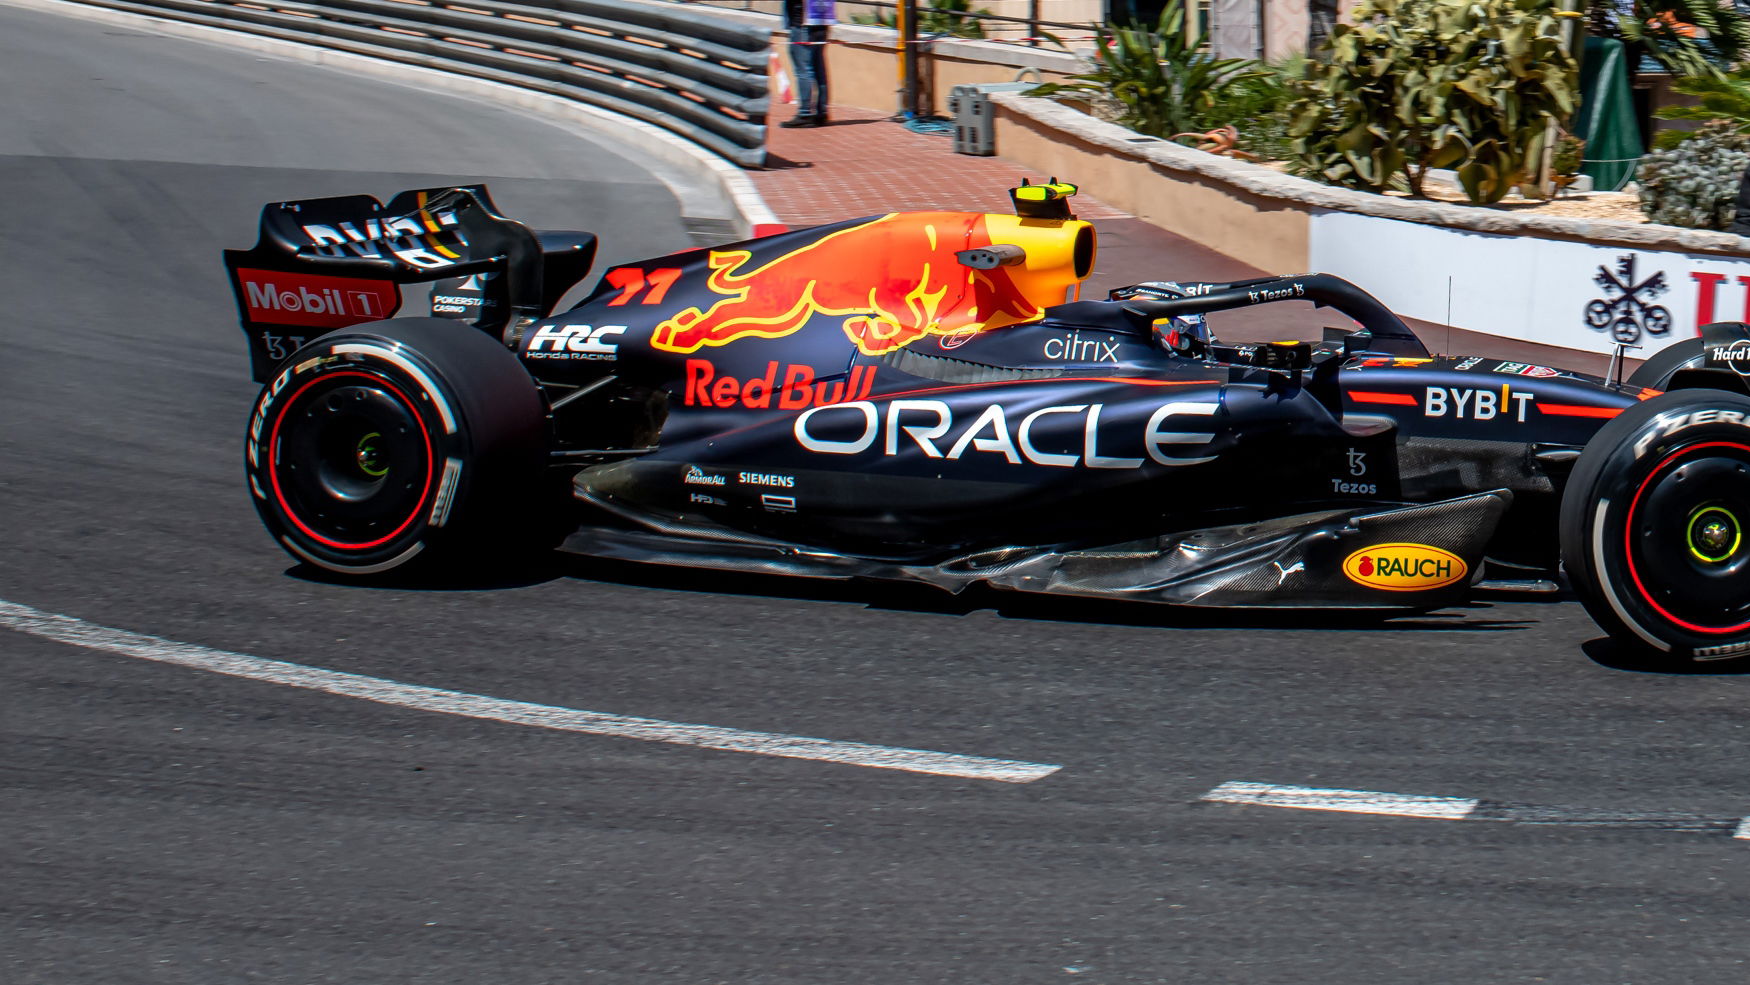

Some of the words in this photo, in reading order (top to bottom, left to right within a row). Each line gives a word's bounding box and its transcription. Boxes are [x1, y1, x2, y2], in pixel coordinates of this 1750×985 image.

[246, 281, 346, 315] Mobil
[1260, 285, 1294, 301] Tezos
[433, 303, 466, 314] CASINO
[527, 324, 628, 353] HRC
[1044, 332, 1120, 363] citrix
[526, 351, 570, 360] Honda
[571, 352, 618, 362] RACING
[1712, 346, 1745, 362] Hard
[685, 360, 779, 409] Red
[779, 363, 877, 410] Bull
[1424, 383, 1535, 423] BYBIT
[793, 399, 1221, 469] ORACLE
[739, 471, 795, 488] SIEMENS
[1331, 478, 1377, 495] Tezos
[1376, 556, 1452, 578] RAUCH
